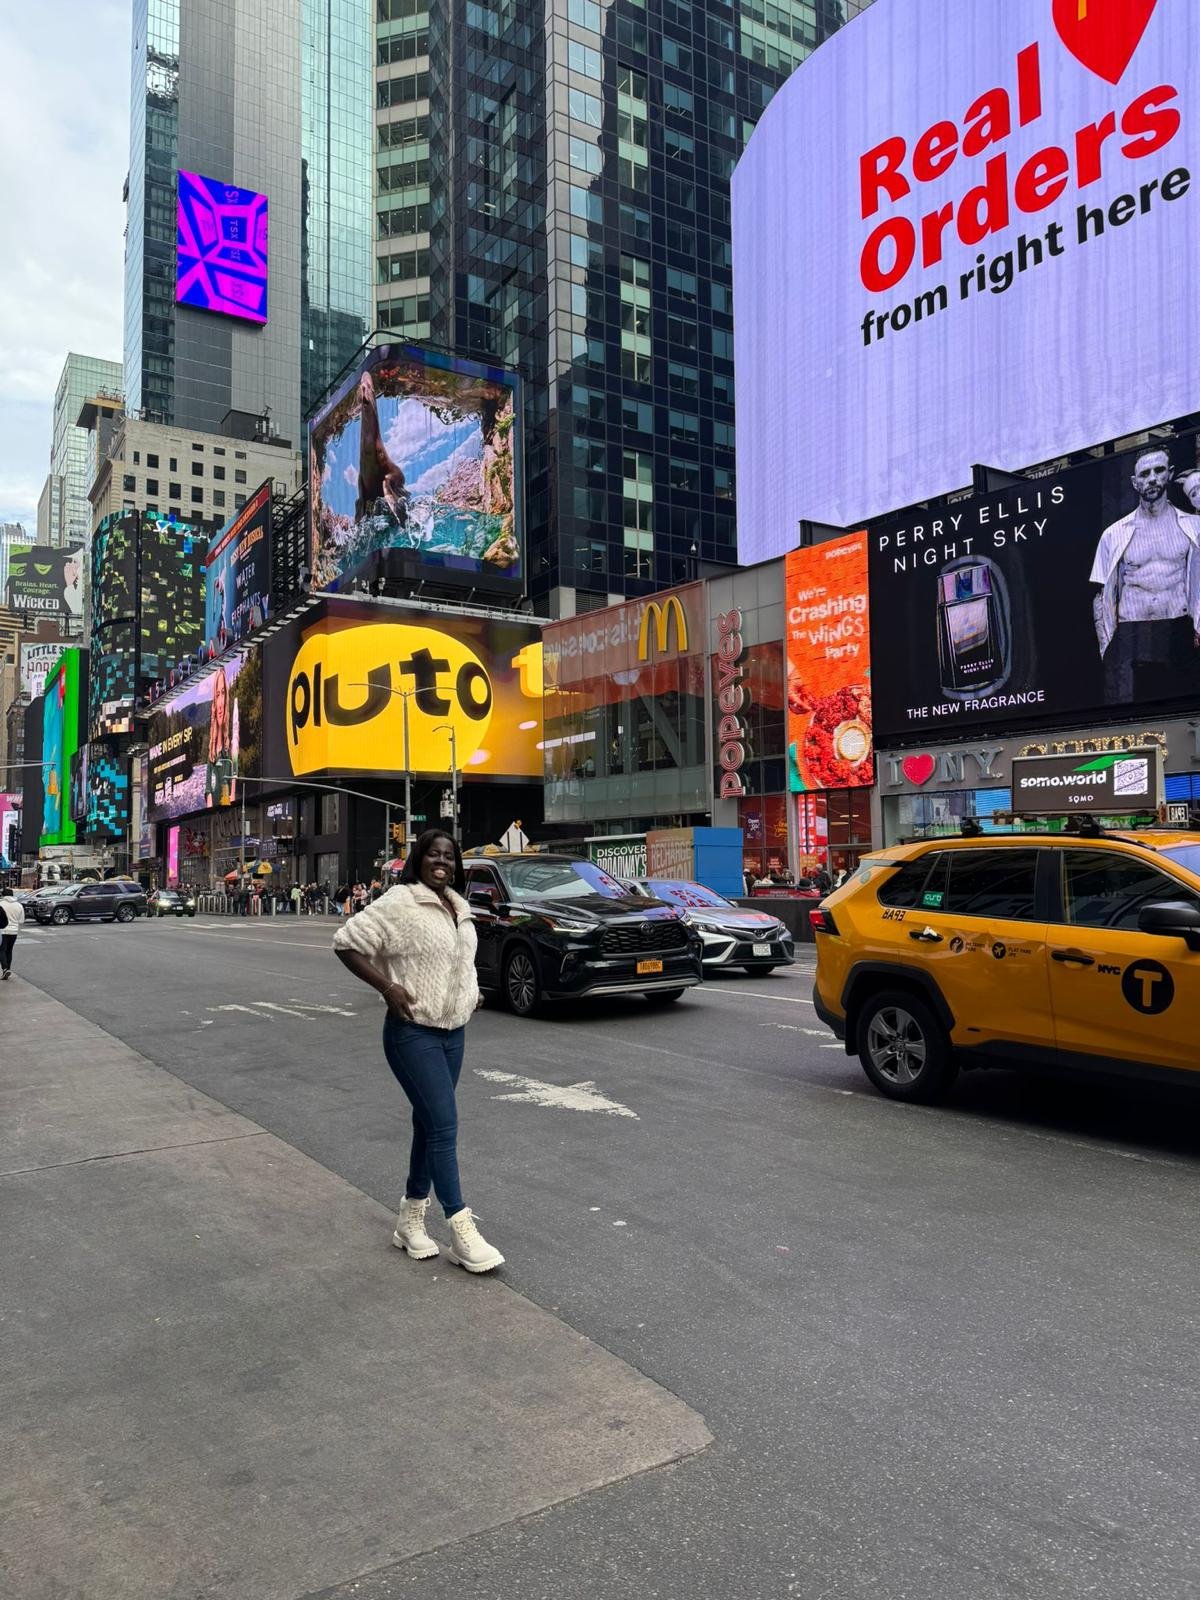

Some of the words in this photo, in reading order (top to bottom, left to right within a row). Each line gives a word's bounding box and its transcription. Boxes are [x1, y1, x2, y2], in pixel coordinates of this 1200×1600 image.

[860, 41, 1042, 220] Real
[860, 84, 1181, 293] Orders
[861, 285, 948, 346] from
[960, 222, 1065, 300] right
[1076, 166, 1191, 244] here
[880, 514, 962, 552] PERRY
[980, 486, 1065, 524] ELLIS
[894, 537, 974, 573] NIGHT
[993, 518, 1048, 547] SKY
[789, 594, 866, 625] Crashing
[27, 644, 57, 661] LITTLE
[825, 642, 860, 661] Party
[292, 647, 491, 746] pluto
[907, 706, 929, 720] THE
[932, 702, 960, 716] NEW
[964, 690, 1045, 711] FRAGRANCE
[887, 756, 903, 787] I
[1020, 770, 1107, 788] somo.world
[597, 844, 648, 858] DISCOVER
[882, 909, 906, 921] 8A93
[1098, 964, 1121, 975] NYC
[1134, 969, 1162, 1007] T
